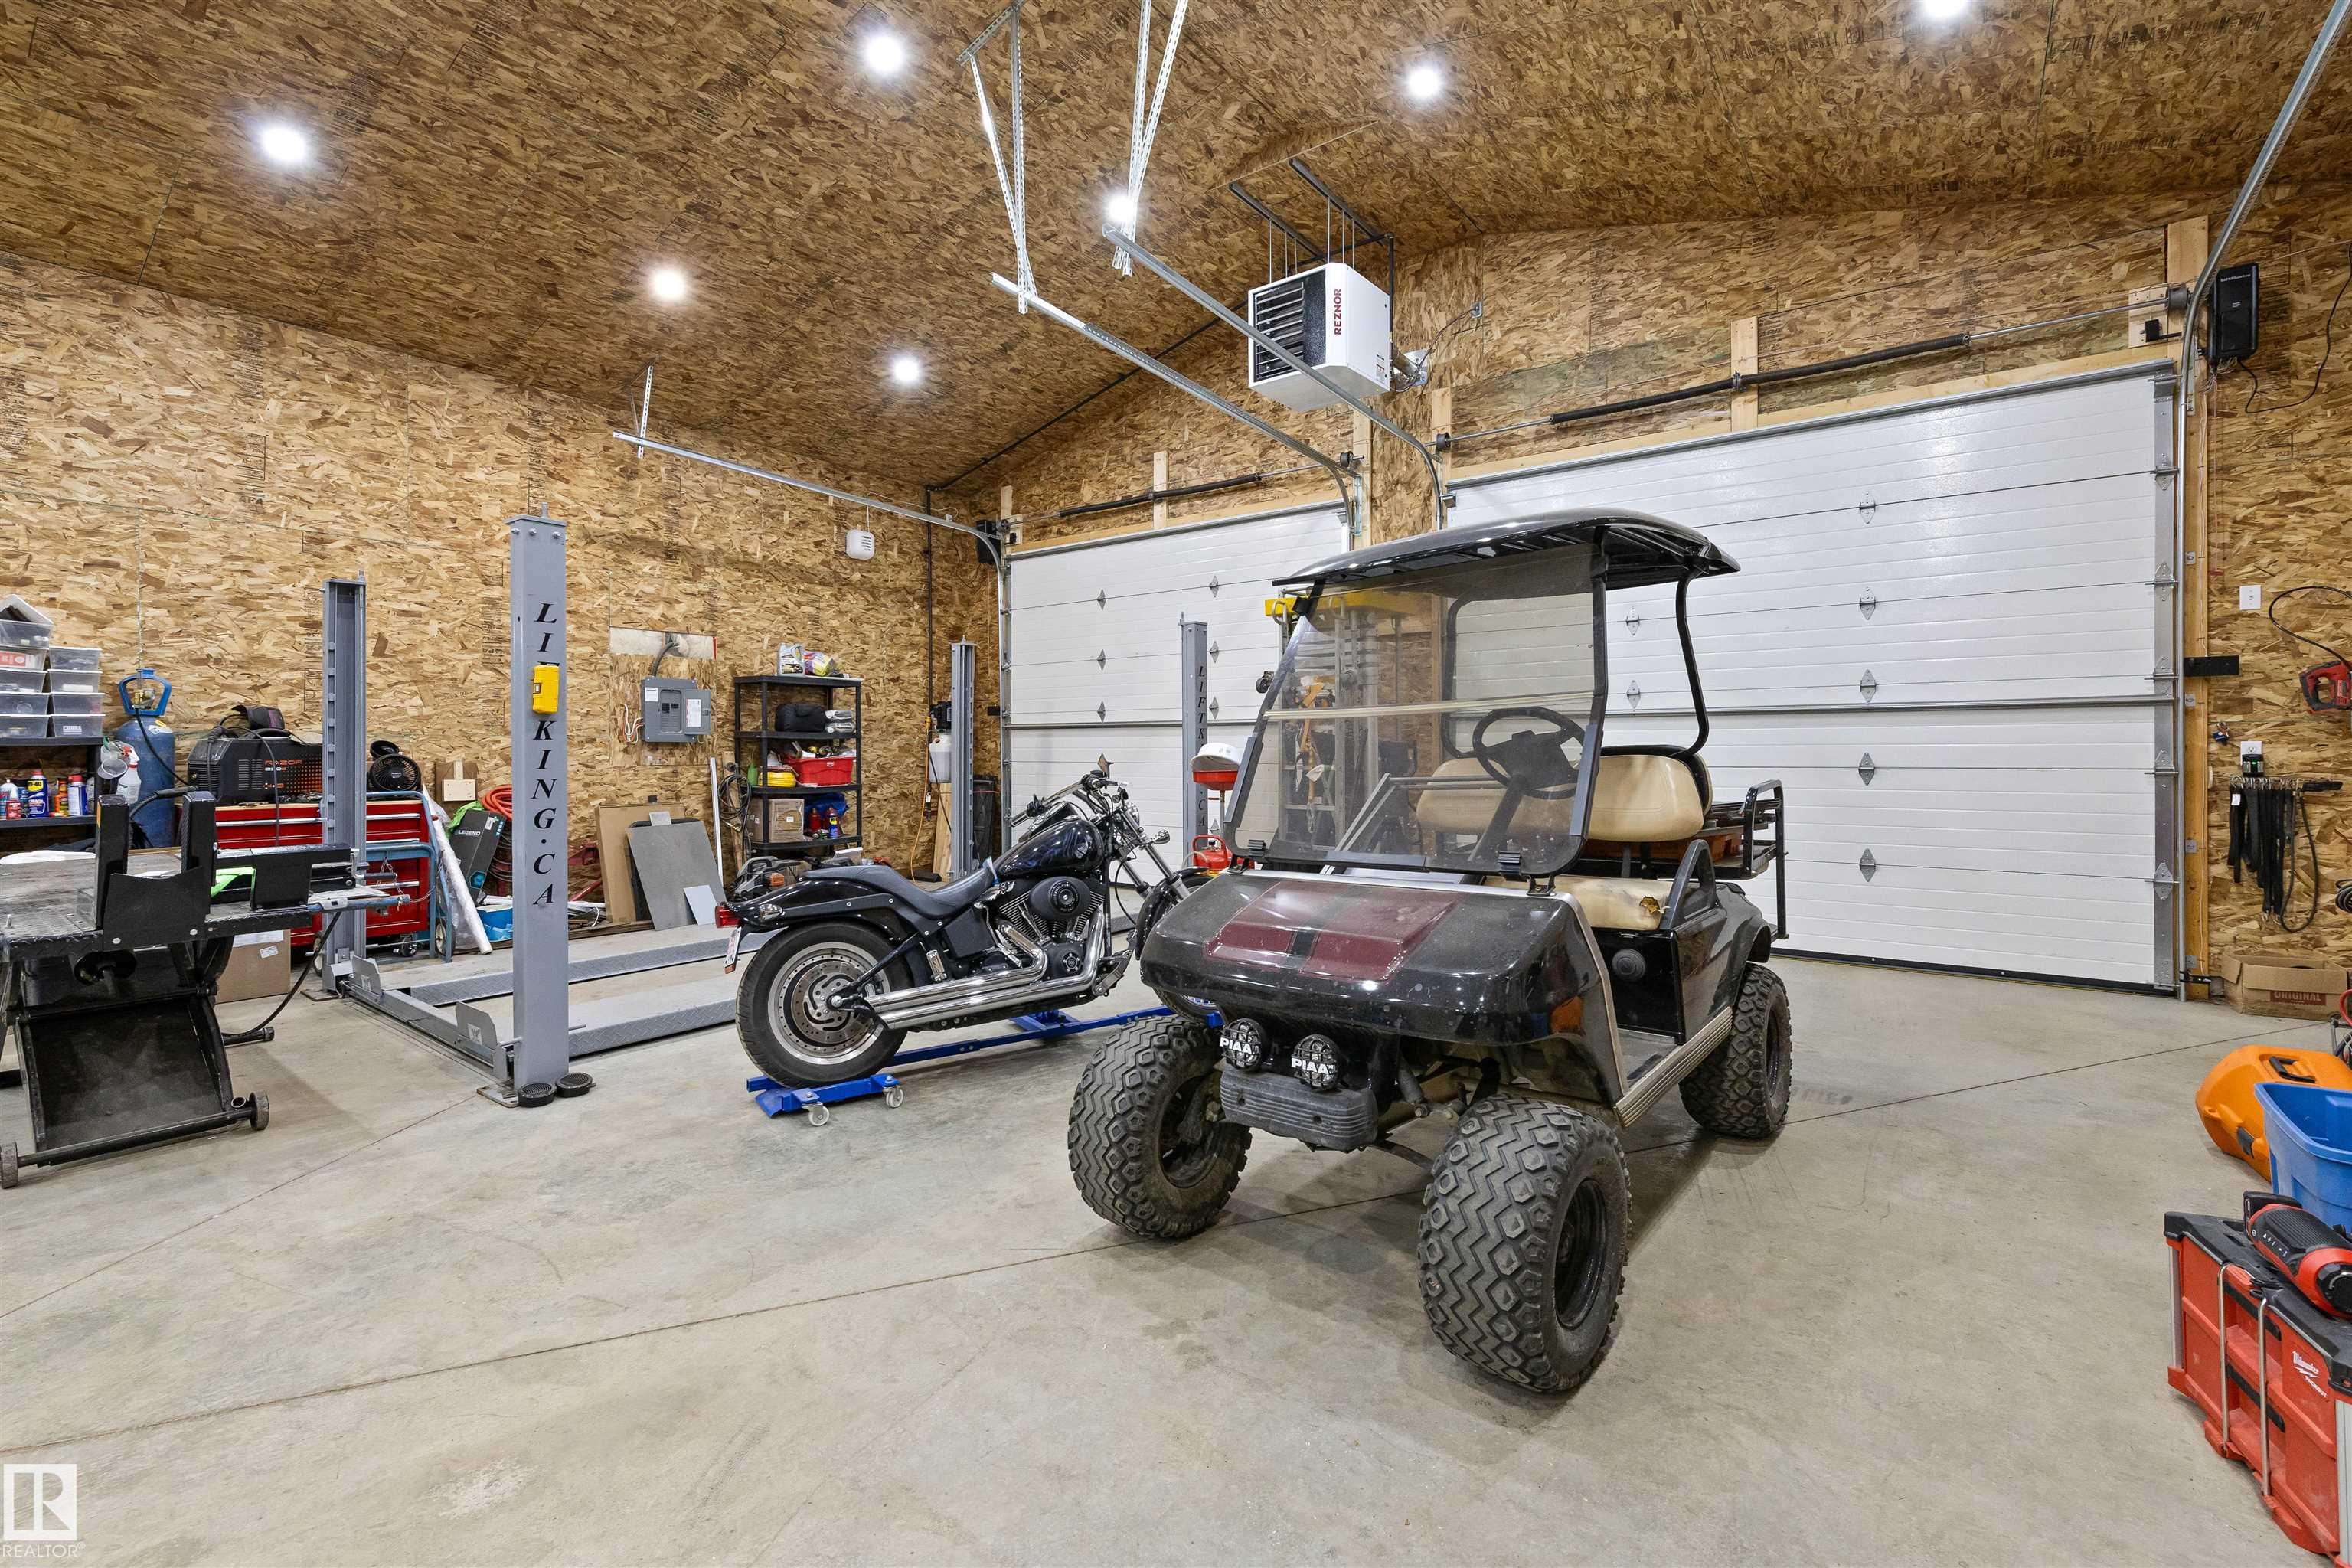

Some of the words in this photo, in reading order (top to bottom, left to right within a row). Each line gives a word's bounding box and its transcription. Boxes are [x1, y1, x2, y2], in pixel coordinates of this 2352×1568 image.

[1333, 288, 1342, 335] REZNOR
[531, 603, 560, 905] LIKING.CA
[1198, 665, 1207, 827] LIFTK.CA
[1219, 1036, 1253, 1055] PIAA
[1291, 1057, 1330, 1075] PIAA
